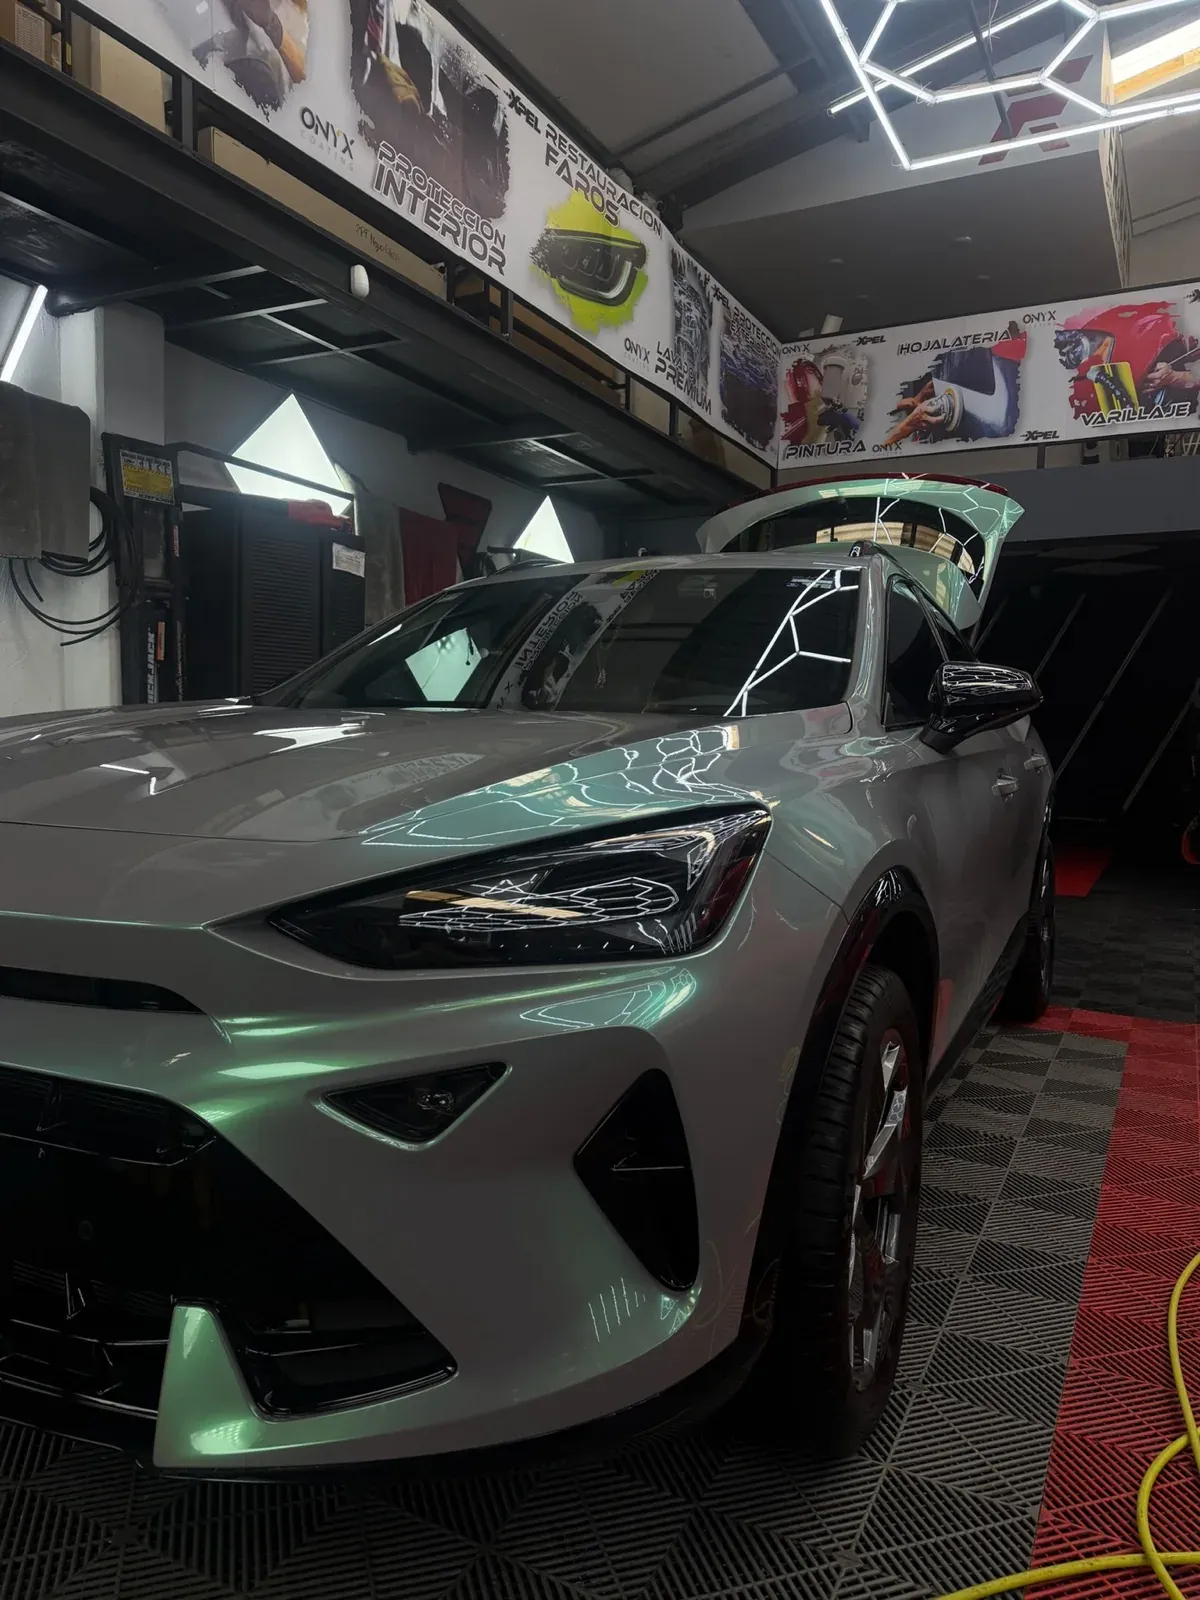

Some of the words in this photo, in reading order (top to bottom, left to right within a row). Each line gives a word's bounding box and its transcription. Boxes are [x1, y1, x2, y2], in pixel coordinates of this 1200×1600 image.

[504, 88, 541, 134] XPEL
[301, 107, 354, 160] ONYX
[544, 142, 621, 227] FAROS
[545, 123, 662, 236] RESTAURACION
[378, 140, 506, 250] PROTECCION
[373, 161, 506, 276] INTERIOR
[711, 284, 730, 310] XPEL
[1022, 310, 1057, 325] ONYX
[624, 337, 650, 364] ONYX
[782, 344, 809, 355] ONYX
[854, 335, 886, 346] XPEL
[898, 330, 1012, 356] HOJALATERIA
[655, 357, 712, 415] PREMIUM
[1080, 402, 1191, 428] VARILLAJE
[872, 441, 902, 453] ONYX
[1021, 430, 1060, 441] XPEL
[784, 440, 867, 460] PINTURA
